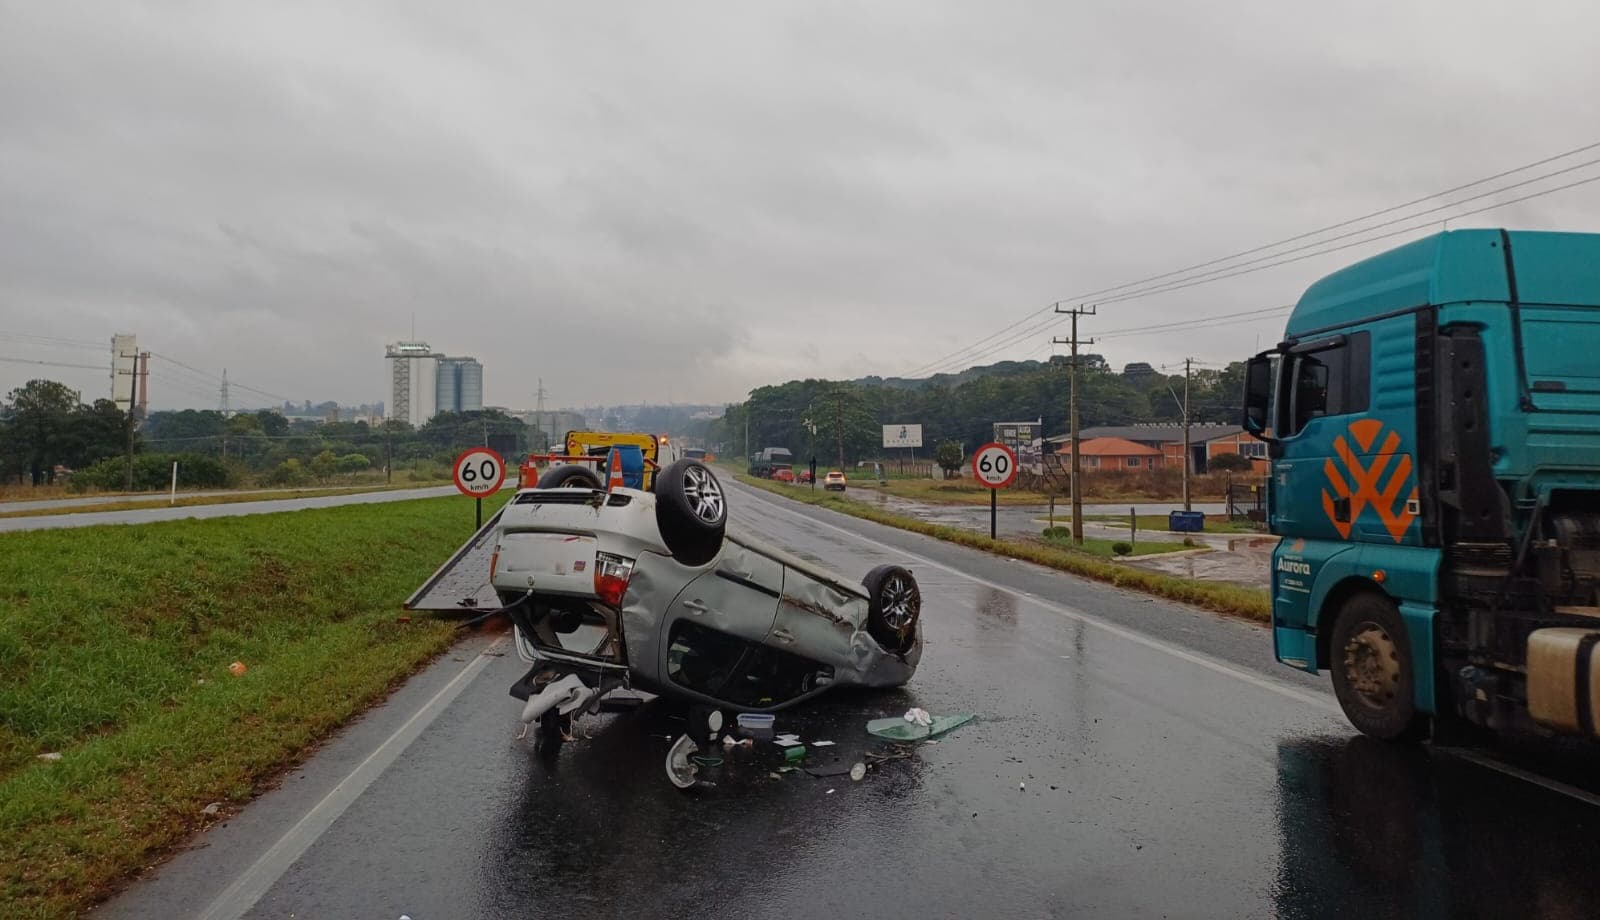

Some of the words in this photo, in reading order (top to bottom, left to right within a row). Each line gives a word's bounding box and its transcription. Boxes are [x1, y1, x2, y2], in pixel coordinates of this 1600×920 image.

[462, 460, 495, 481] 60
[980, 455, 1007, 473] 60
[1278, 557, 1311, 575] Aurora
